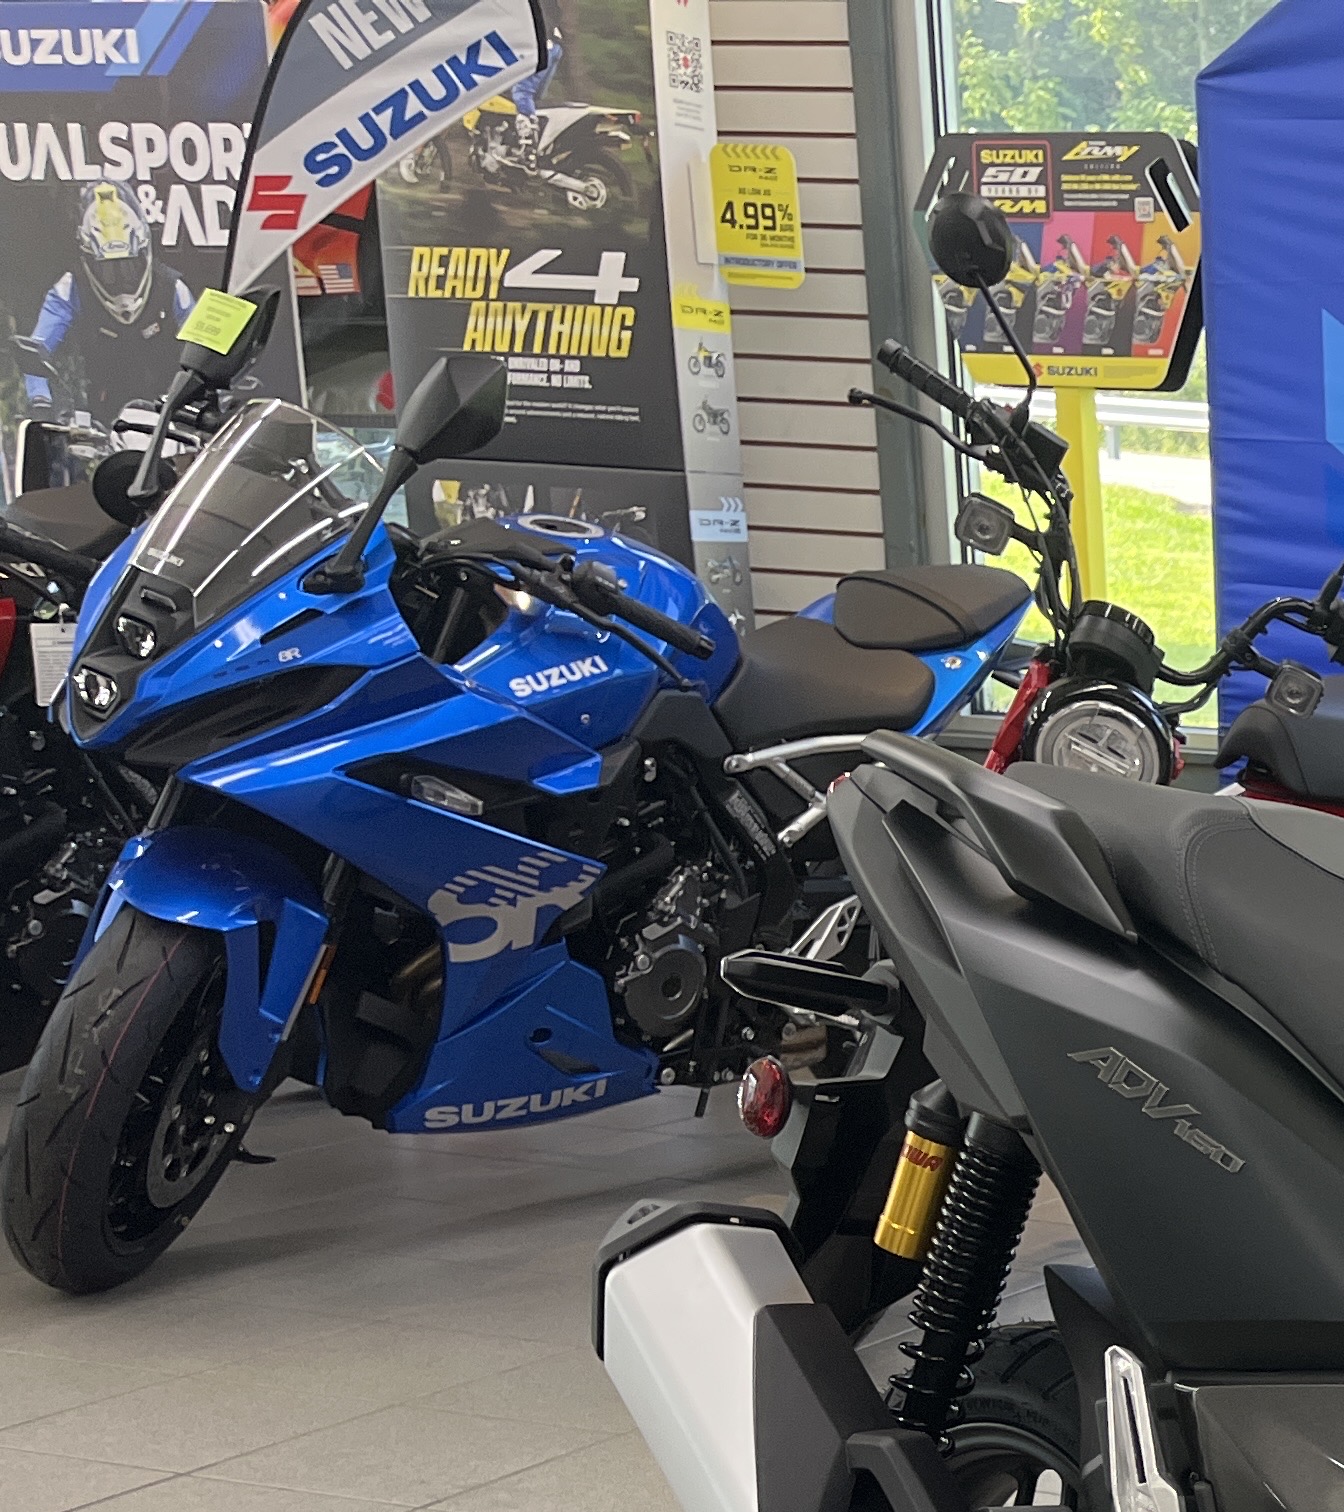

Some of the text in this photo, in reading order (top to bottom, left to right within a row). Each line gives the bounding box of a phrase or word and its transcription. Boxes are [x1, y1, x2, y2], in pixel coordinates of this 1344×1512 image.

[0, 29, 140, 65] UZUKI
[308, 0, 432, 70] NEW
[304, 30, 518, 188] SUZUKI
[980, 149, 1044, 164] SUZUKI
[981, 167, 1044, 183] 50
[408, 246, 640, 305] READY 4
[463, 301, 635, 358] ANYTHING
[1047, 366, 1098, 377] SUZUKI
[509, 655, 609, 698] SUZUKI
[424, 1078, 608, 1129] SUZUKI
